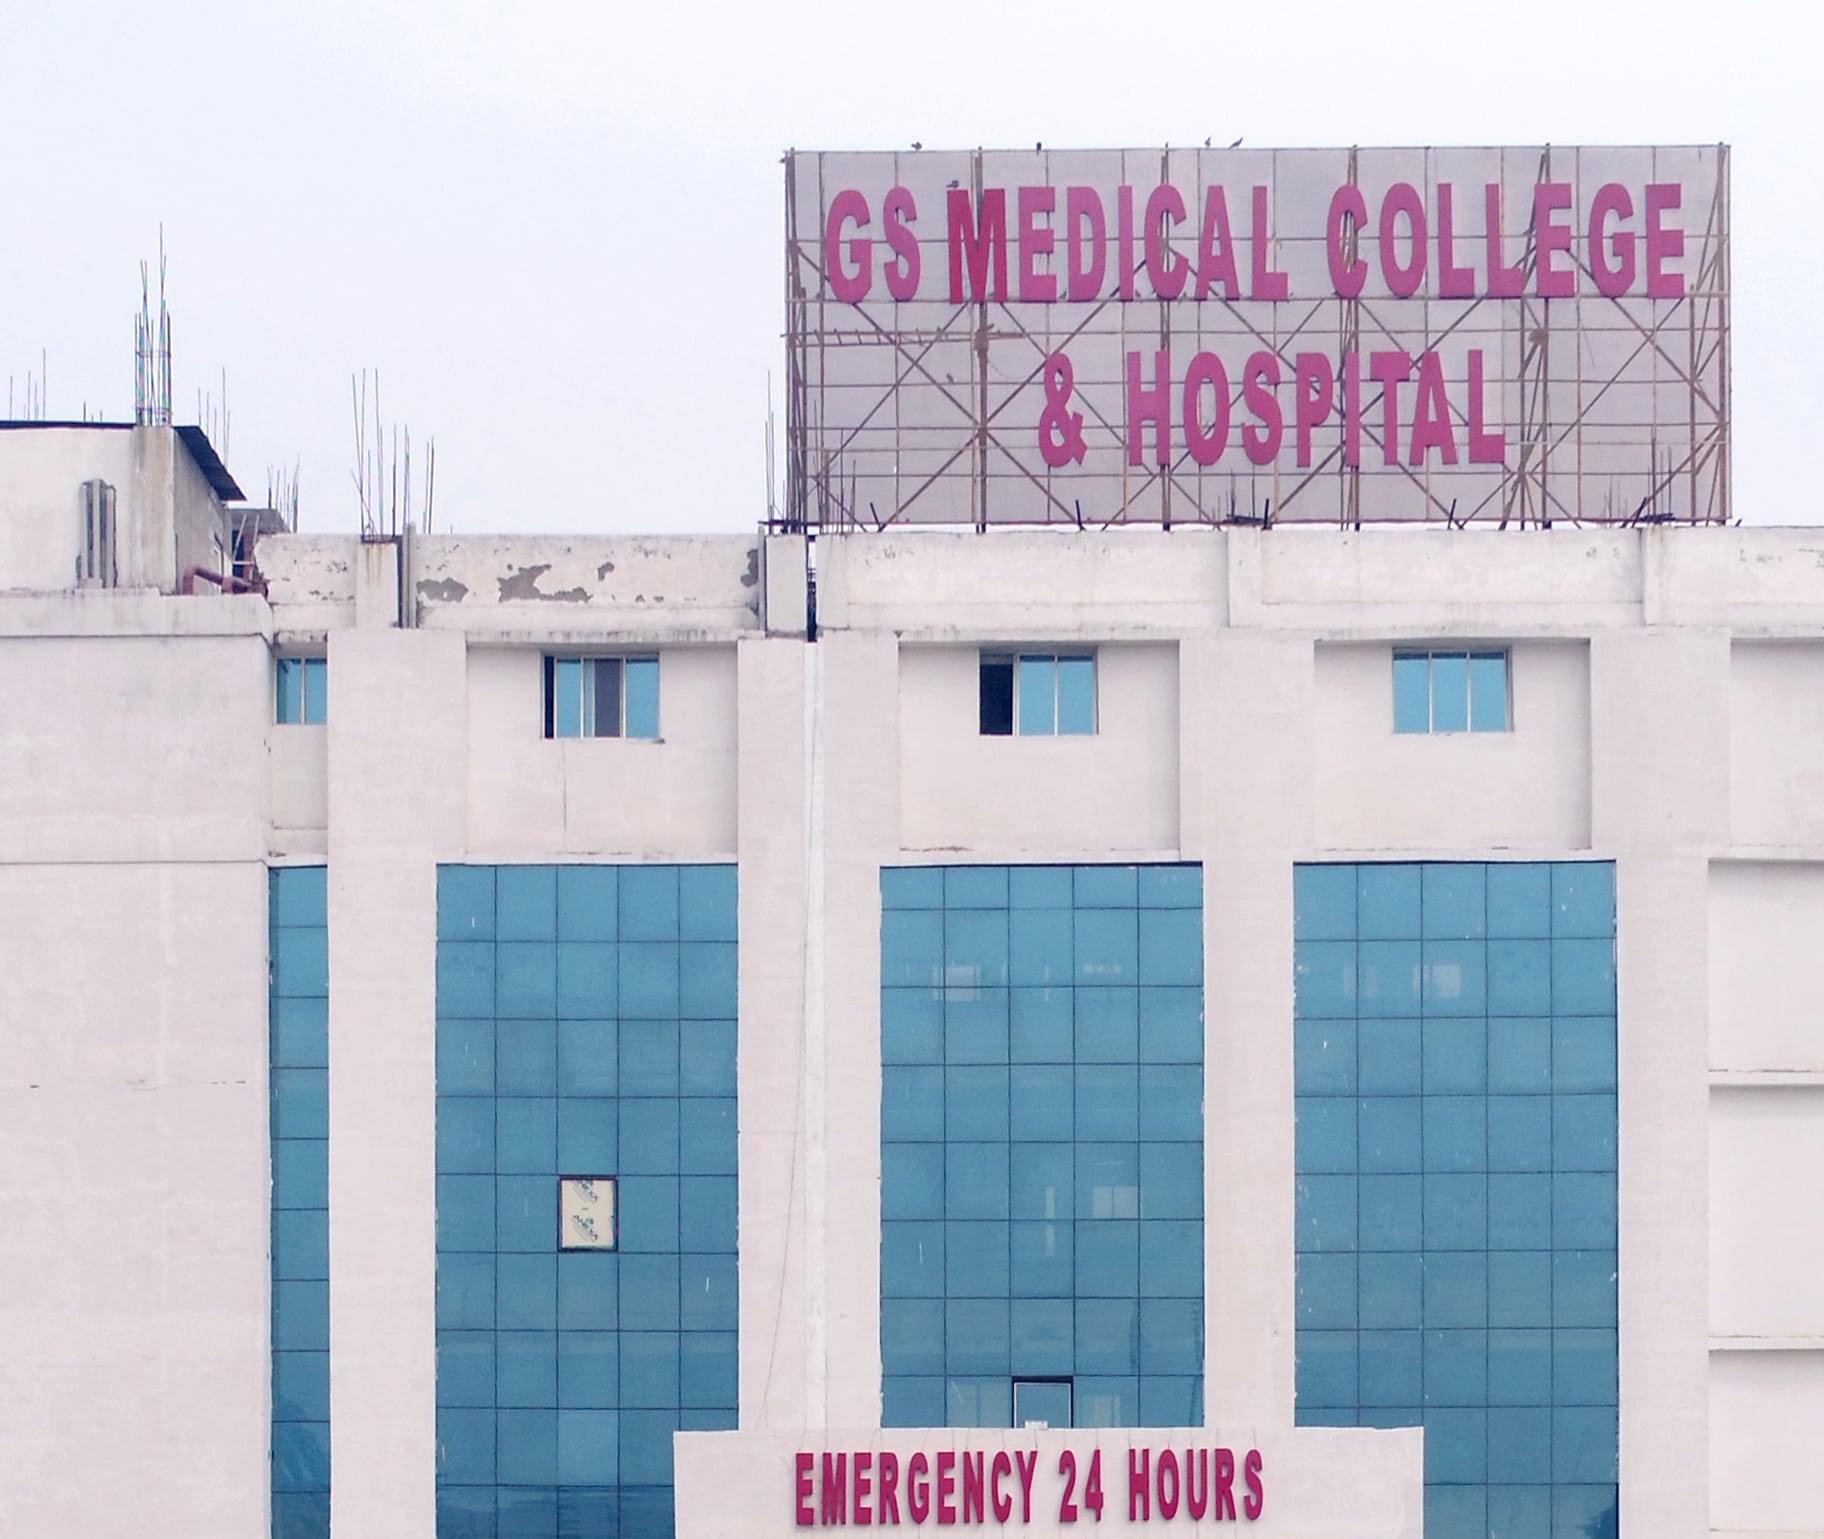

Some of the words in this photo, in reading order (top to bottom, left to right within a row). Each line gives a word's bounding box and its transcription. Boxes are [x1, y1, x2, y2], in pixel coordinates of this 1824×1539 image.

[824, 185, 922, 303] GS
[947, 183, 1289, 304] MEDICAL
[1326, 181, 1685, 300] COLLEGE
[1037, 352, 1088, 467] &
[1127, 349, 1507, 467] HOSPITAL
[794, 1450, 1037, 1526] EMERGENCY
[1058, 1449, 1104, 1523] 24
[1128, 1446, 1265, 1523] HOURS
